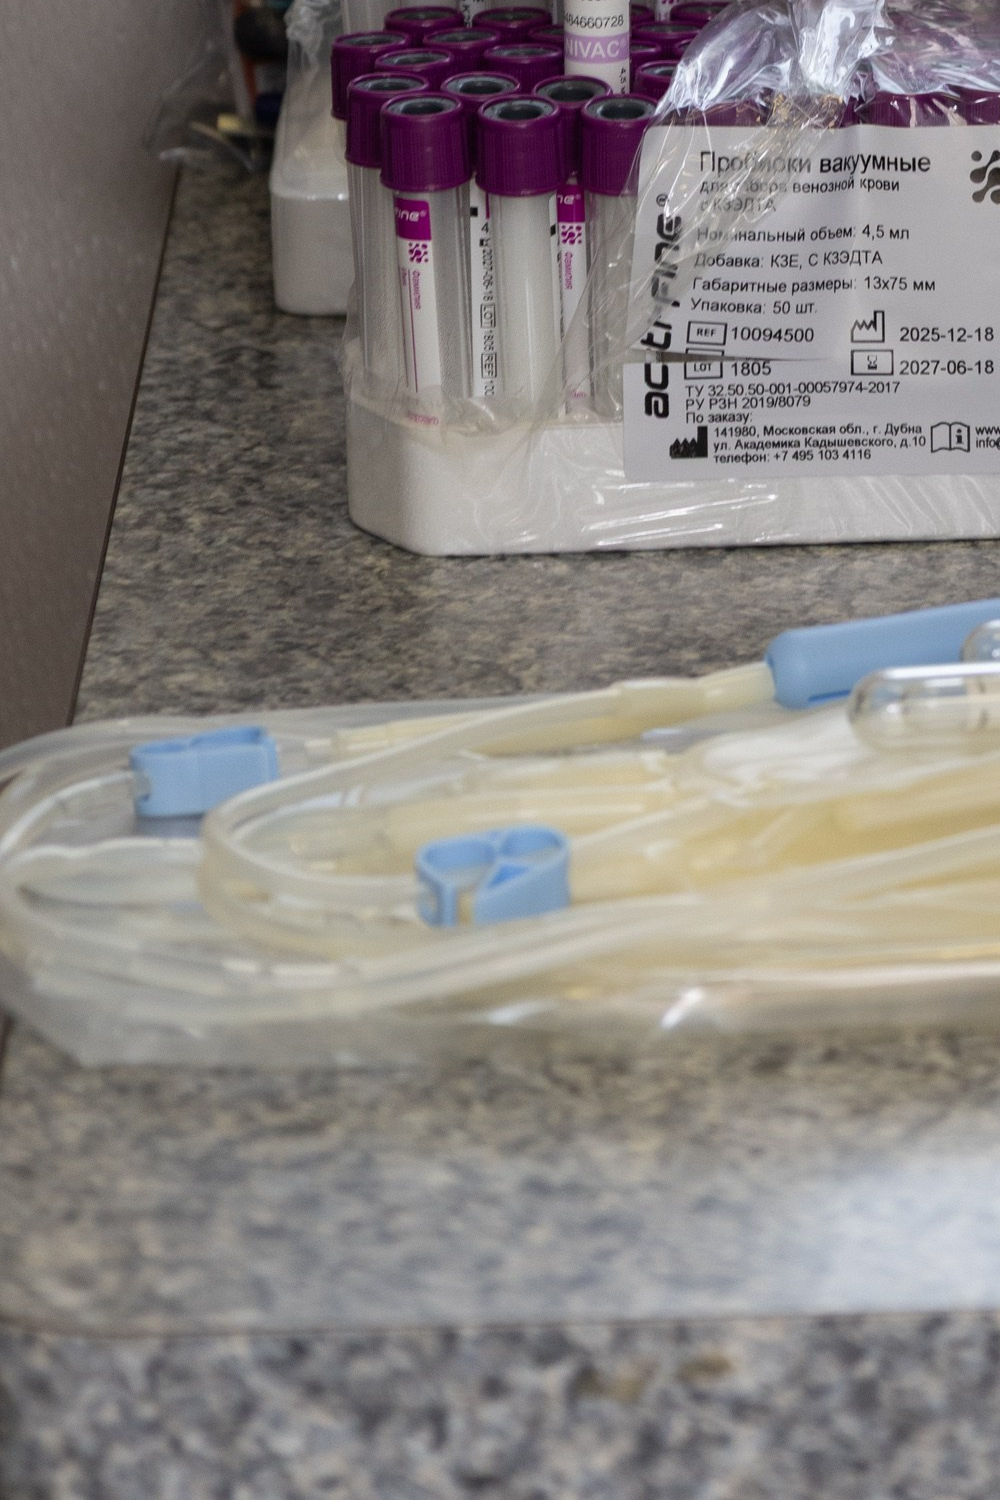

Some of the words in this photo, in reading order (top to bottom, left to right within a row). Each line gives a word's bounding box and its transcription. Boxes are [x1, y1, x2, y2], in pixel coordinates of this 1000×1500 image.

[819, 153, 930, 174] вакуумные
[730, 181, 787, 194] бора
[793, 176, 855, 193] венозной
[859, 179, 899, 192] крови
[810, 226, 856, 242] объем:
[862, 225, 885, 242] 4,5
[889, 229, 910, 240] мл
[694, 254, 764, 269] Добавка:
[692, 278, 787, 295] Габаритные
[791, 278, 857, 296] размеры:
[913, 280, 936, 292] мм
[690, 298, 766, 315] Упаковка:
[773, 300, 791, 314] 50
[795, 301, 818, 314] шт.
[697, 328, 717, 338] REF
[730, 326, 814, 342] 10094500
[899, 325, 995, 345] 2025-12-18
[693, 363, 712, 372] LOT
[730, 360, 772, 377] 1805
[899, 359, 995, 378] 2027-06-18
[685, 385, 704, 398] ТУ
[708, 381, 900, 397] 32.50.50-001-00057974-2017
[685, 398, 704, 411] РУ
[742, 395, 811, 410] 2019/8079
[686, 412, 704, 424] По
[708, 412, 752, 425] заказу:
[714, 426, 760, 437] 141980,
[763, 424, 837, 437] Московская
[839, 423, 869, 436] обл.,
[872, 425, 881, 435] г.
[884, 423, 922, 436] Дубна
[713, 440, 732, 452] ул.
[735, 438, 801, 450] Академика
[804, 437, 897, 449] Кадышевского,
[899, 436, 926, 448] д.10
[713, 452, 770, 465] телефон:
[773, 451, 788, 462] +7
[791, 450, 814, 462] 495
[817, 450, 839, 462] 103
[842, 449, 872, 461] 4116
